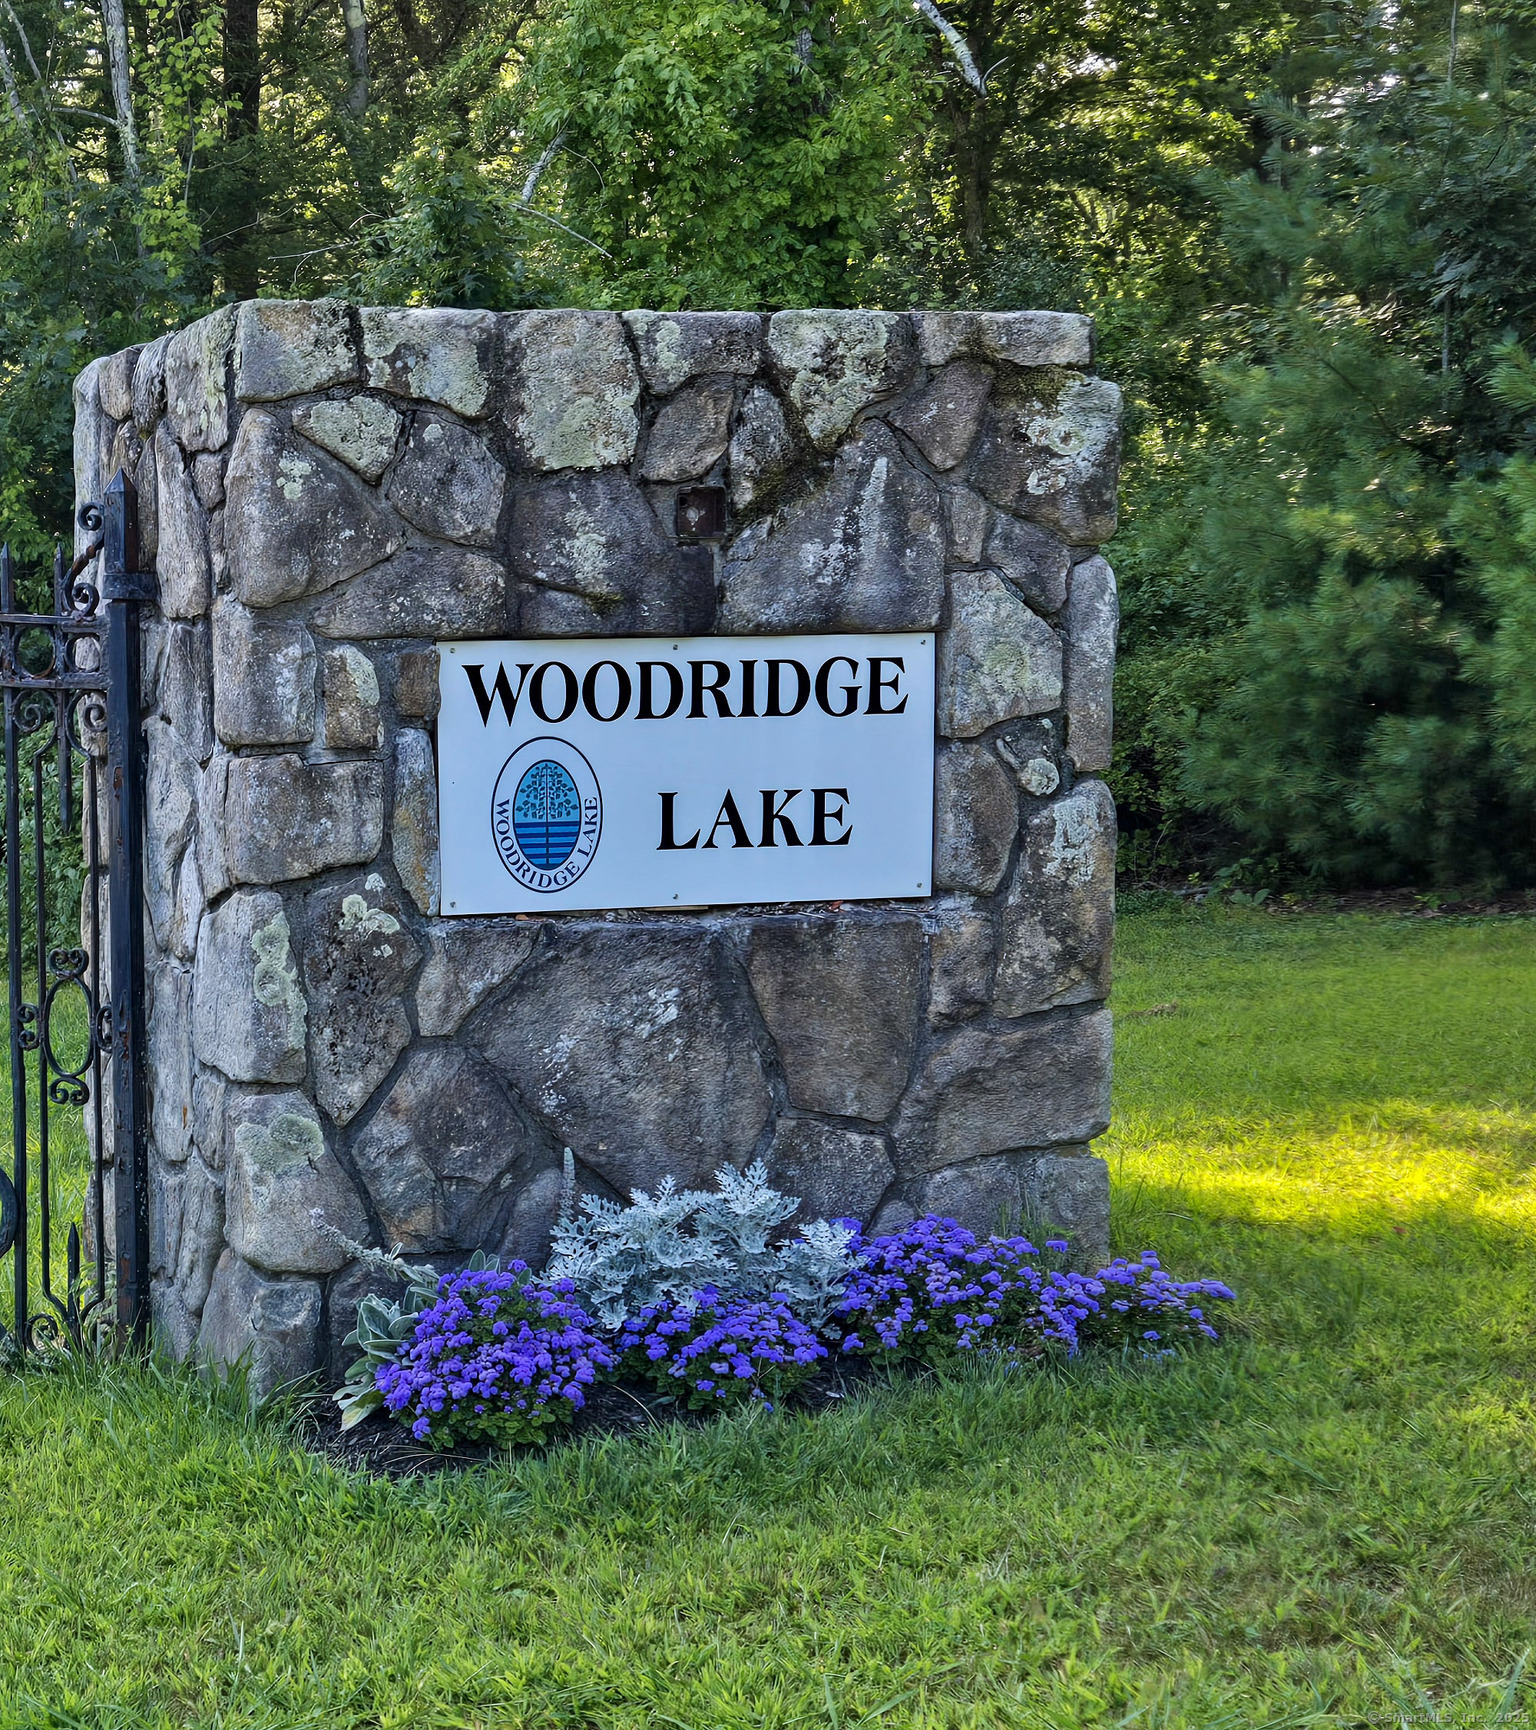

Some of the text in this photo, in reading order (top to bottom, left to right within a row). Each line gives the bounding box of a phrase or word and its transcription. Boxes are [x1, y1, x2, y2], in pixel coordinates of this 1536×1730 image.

[462, 656, 909, 728] WOODRIDGE
[496, 796, 598, 888] WOODRIDGE LAKE
[656, 787, 853, 851] LAKE
